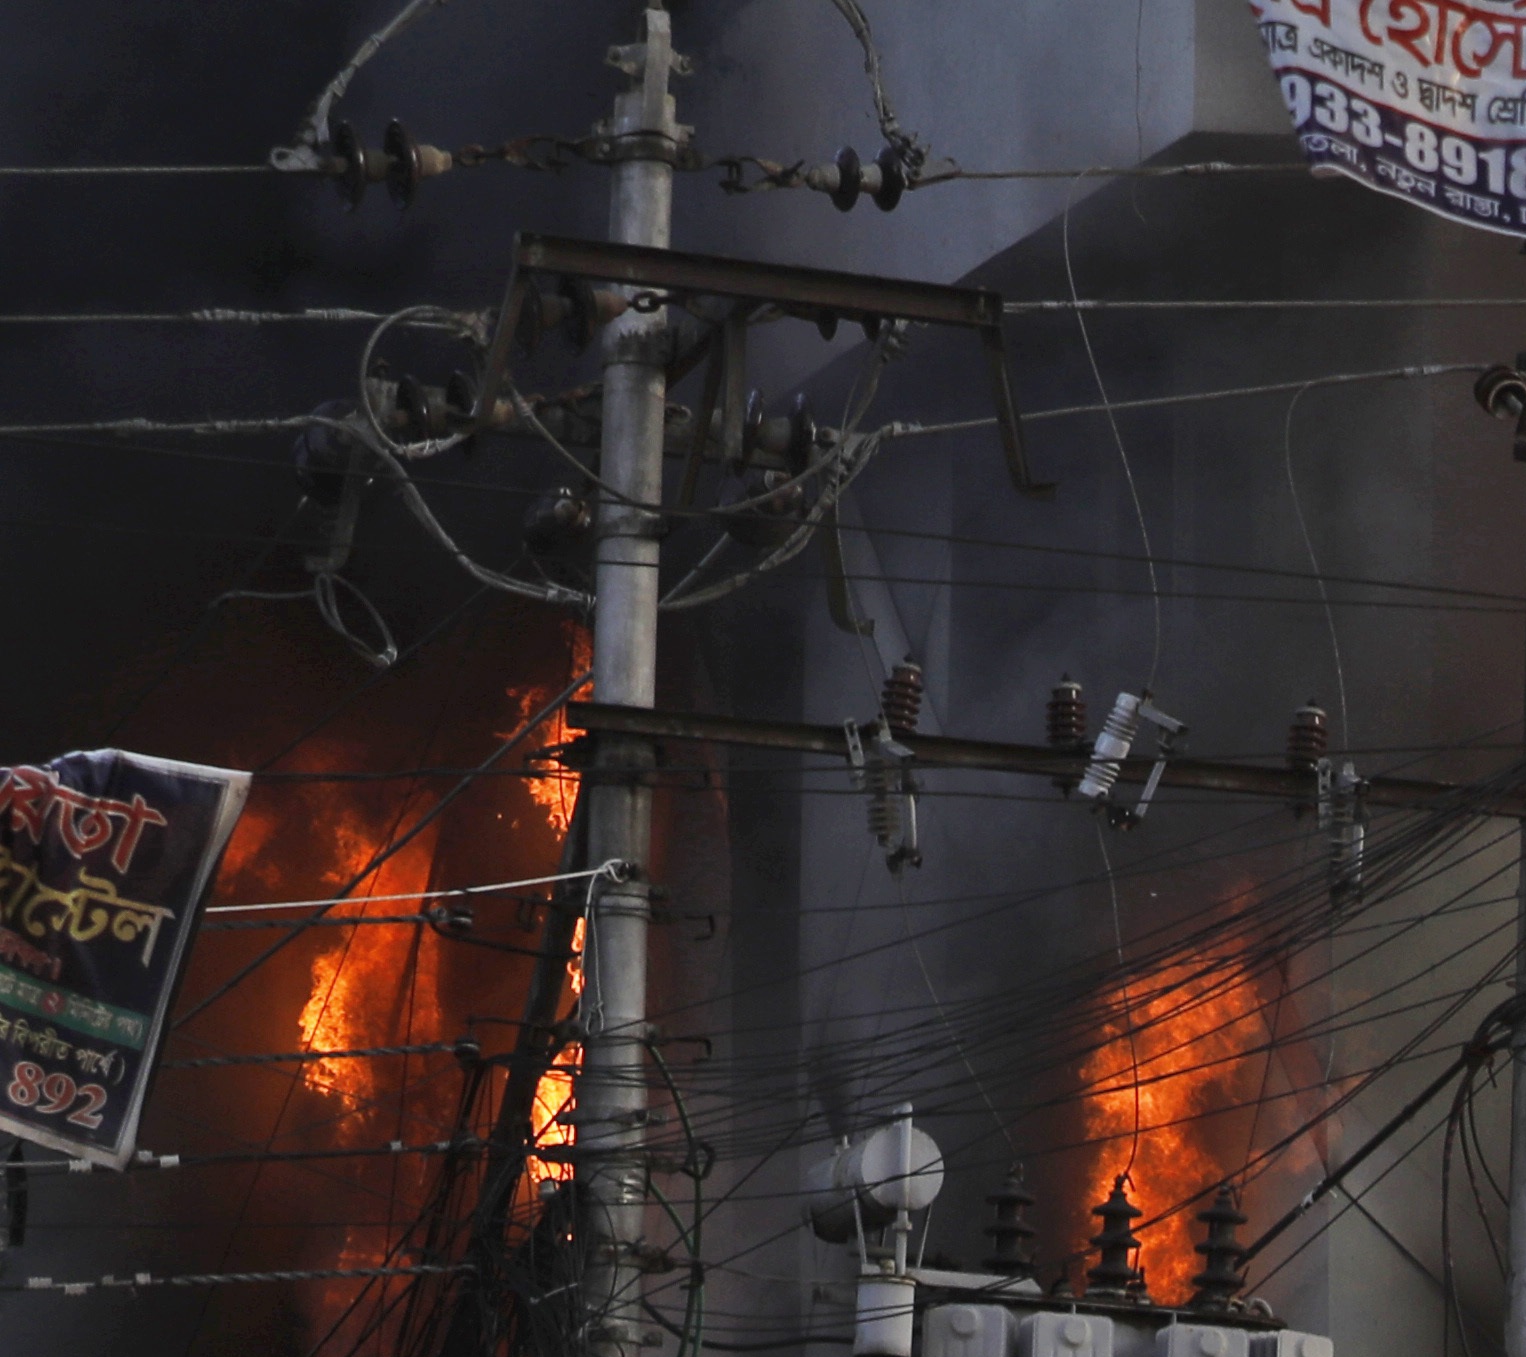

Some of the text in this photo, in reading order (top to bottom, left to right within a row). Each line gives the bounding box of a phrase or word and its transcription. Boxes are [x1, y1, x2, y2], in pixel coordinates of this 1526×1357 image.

[1308, 38, 1385, 90] একাদশ
[1392, 73, 1409, 99] ও
[1418, 76, 1477, 124] দ্বাদশ
